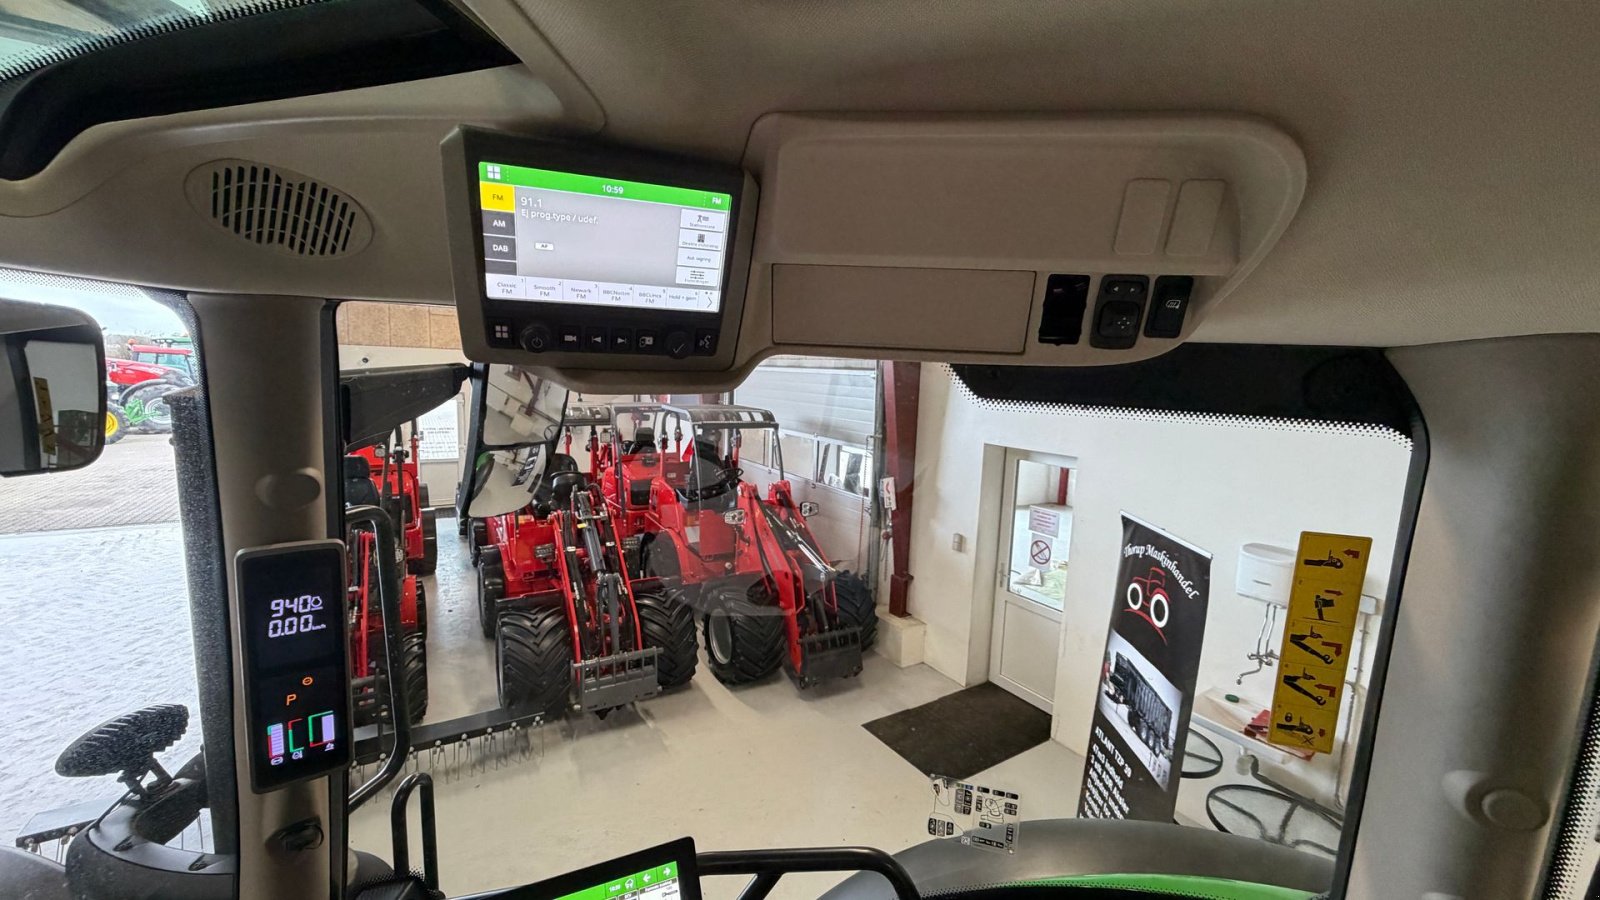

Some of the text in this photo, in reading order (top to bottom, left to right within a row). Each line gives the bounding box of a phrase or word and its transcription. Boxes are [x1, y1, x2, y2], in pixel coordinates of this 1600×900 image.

[602, 184, 624, 195] 10:59
[492, 193, 504, 202] FM
[520, 196, 543, 209] 91.1
[711, 196, 722, 205] FM
[521, 208, 530, 219] Ej
[531, 210, 571, 223] prog.type
[578, 214, 599, 225] udef.
[492, 219, 506, 228] AM
[492, 243, 508, 253] DAB
[496, 281, 517, 290] Classic
[533, 284, 556, 293] Smooth
[1123, 543, 1200, 600] Thorup Maskinhandel
[271, 595, 312, 618] 940
[268, 614, 313, 638] 0.00
[286, 693, 297, 706] P
